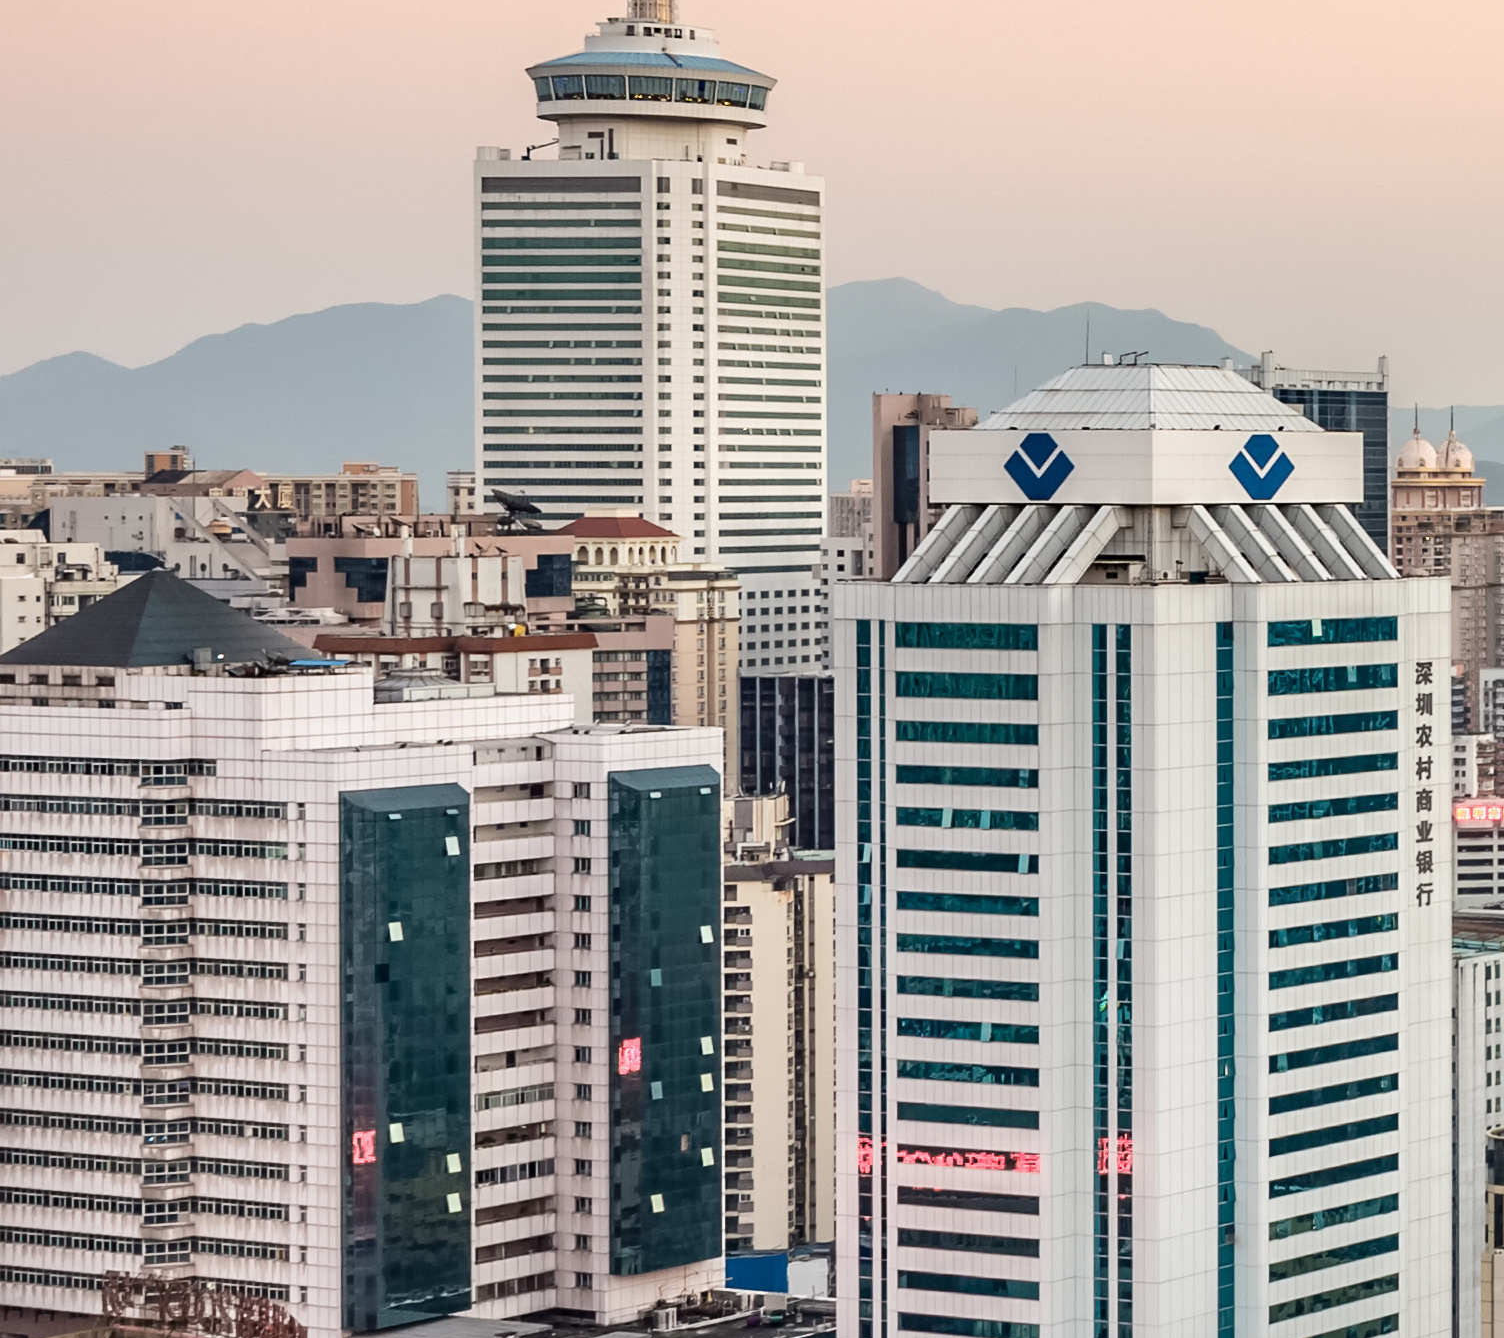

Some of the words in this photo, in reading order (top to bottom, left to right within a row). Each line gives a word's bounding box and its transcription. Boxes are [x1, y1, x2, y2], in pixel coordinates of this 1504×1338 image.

[1415, 661, 1434, 907] 深圳农村商业银行
